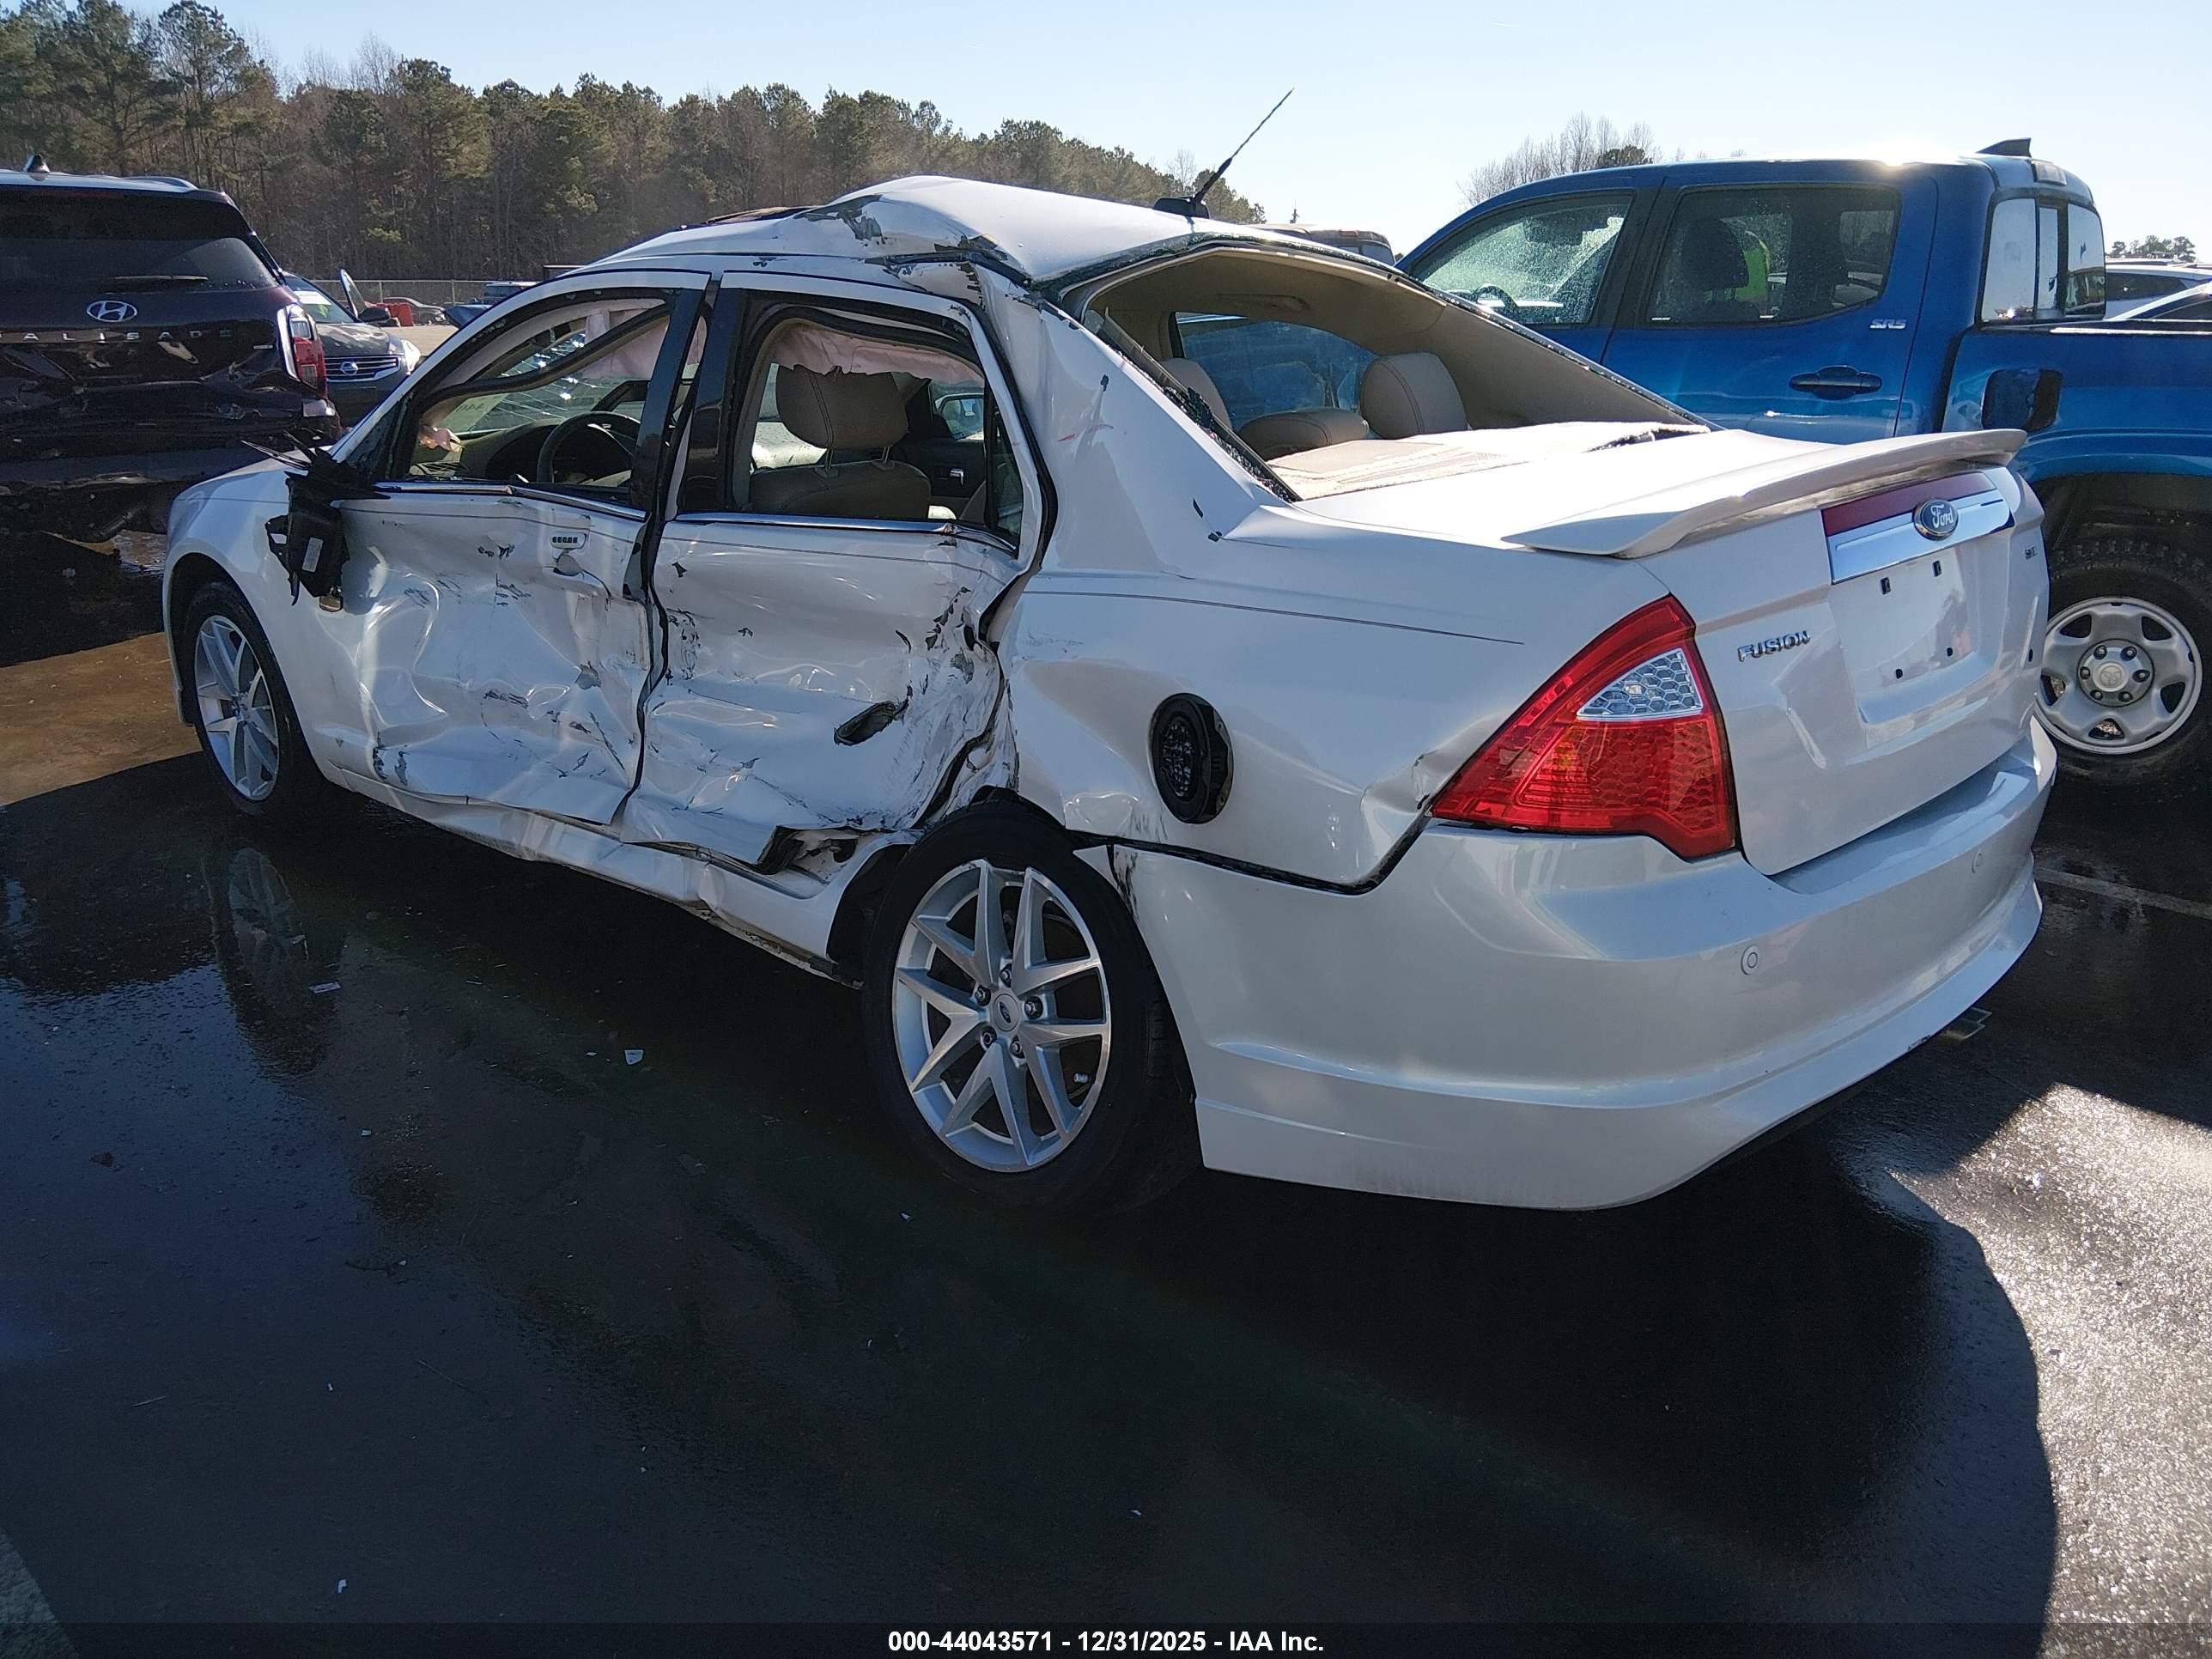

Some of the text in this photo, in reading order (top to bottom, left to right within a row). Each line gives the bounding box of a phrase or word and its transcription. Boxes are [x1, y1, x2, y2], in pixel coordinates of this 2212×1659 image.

[0, 329, 233, 343] ALISADE
[1930, 504, 1954, 528] Ford
[1737, 630, 1811, 663] FUSION
